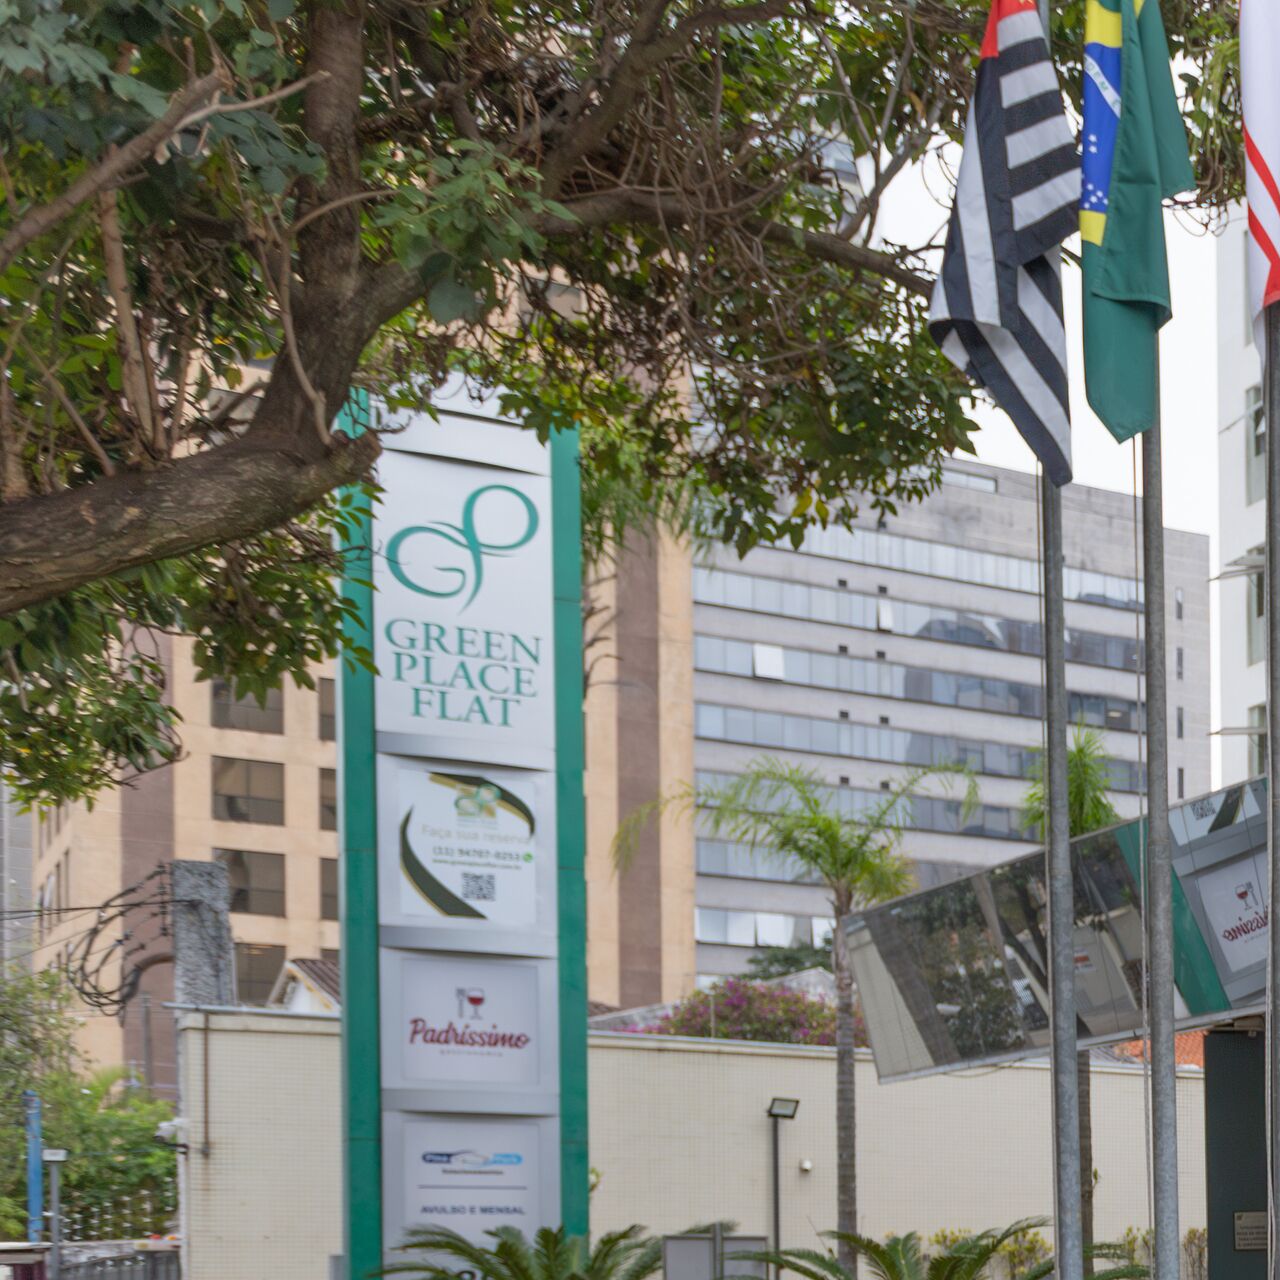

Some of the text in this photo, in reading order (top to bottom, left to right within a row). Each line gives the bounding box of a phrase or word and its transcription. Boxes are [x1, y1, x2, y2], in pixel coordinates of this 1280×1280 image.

[384, 618, 543, 666] GREEN
[392, 651, 539, 699] PLACE
[410, 687, 522, 728] FLAT
[420, 1204, 526, 1216] AVULSO E MENSAL
